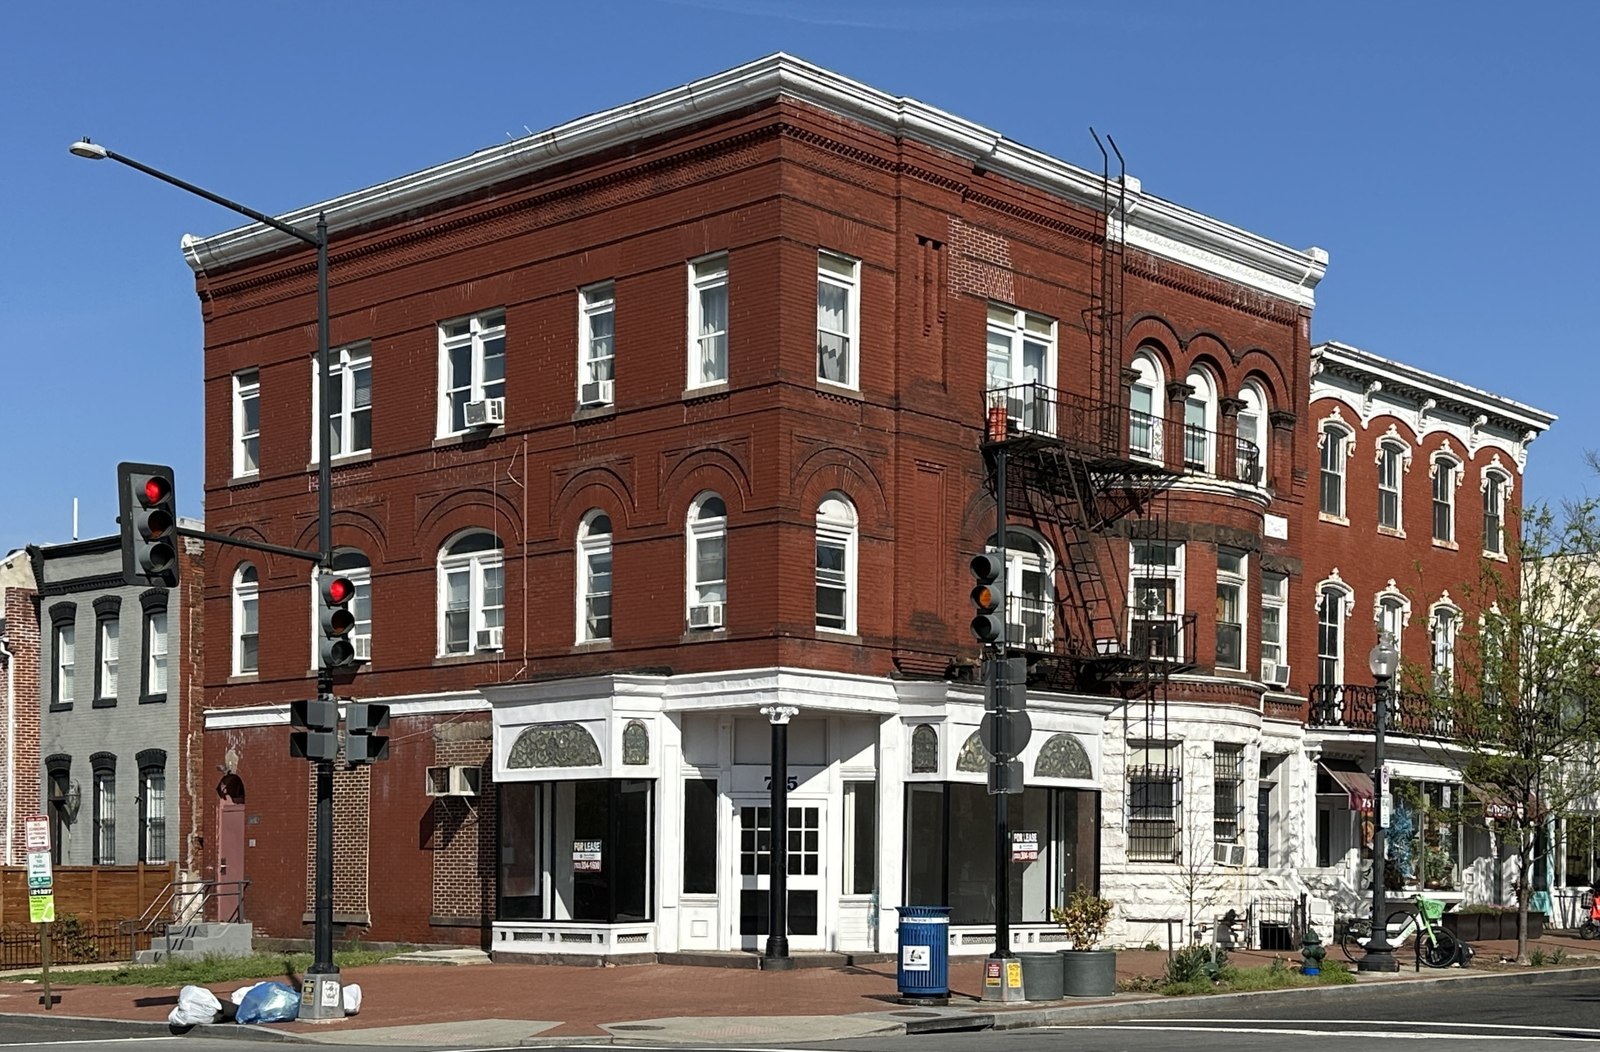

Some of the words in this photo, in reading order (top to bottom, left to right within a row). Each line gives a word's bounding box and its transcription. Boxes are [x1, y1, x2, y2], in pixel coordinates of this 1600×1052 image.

[764, 775, 798, 791] 75
[1013, 832, 1023, 843] FOR
[1024, 832, 1037, 843] LEASE
[573, 841, 584, 852] FOR
[584, 841, 600, 852] LEASE
